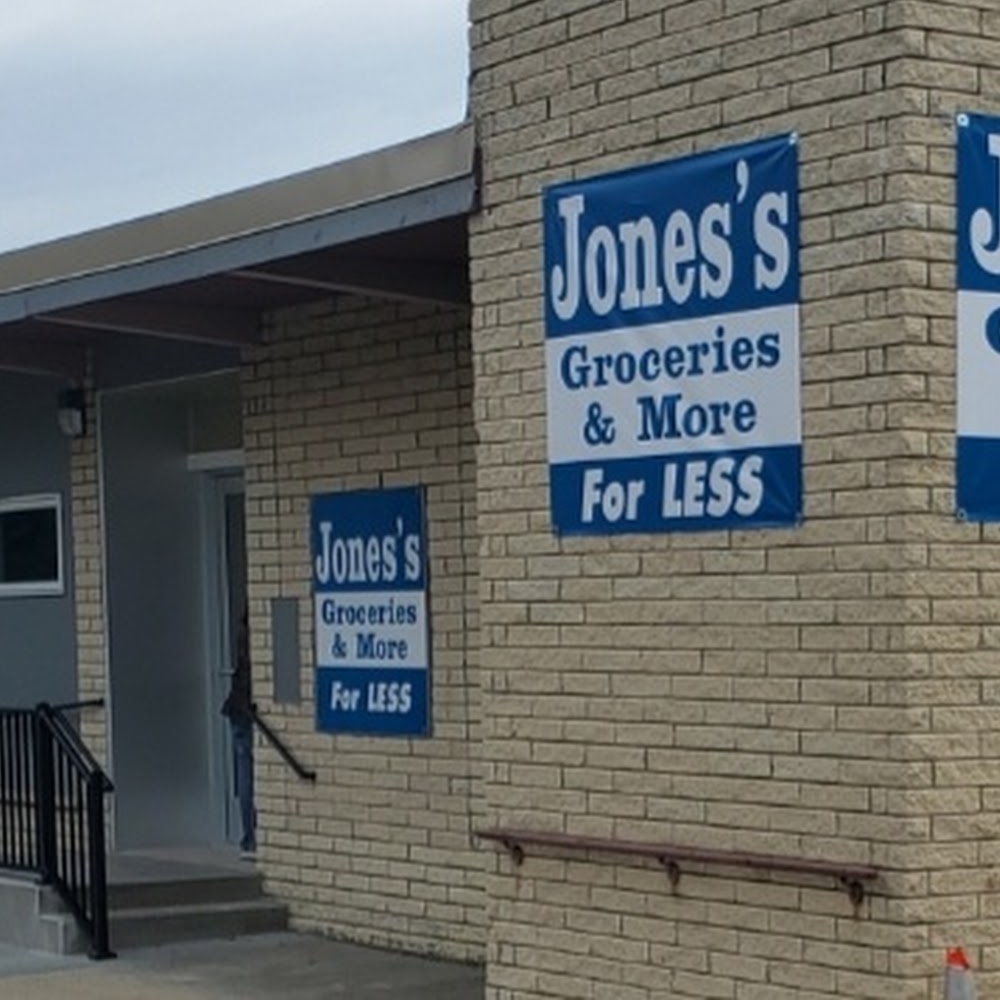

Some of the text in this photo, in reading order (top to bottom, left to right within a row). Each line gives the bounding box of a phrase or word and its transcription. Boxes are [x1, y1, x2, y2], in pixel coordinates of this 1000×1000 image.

[551, 159, 790, 320] Jones's
[560, 326, 781, 389] Groceries
[583, 394, 757, 446] & More
[581, 455, 764, 523] For LESS
[316, 517, 420, 584] Jones's
[322, 598, 417, 625] Groceries
[332, 633, 408, 660] & More
[331, 681, 412, 713] For LESS
